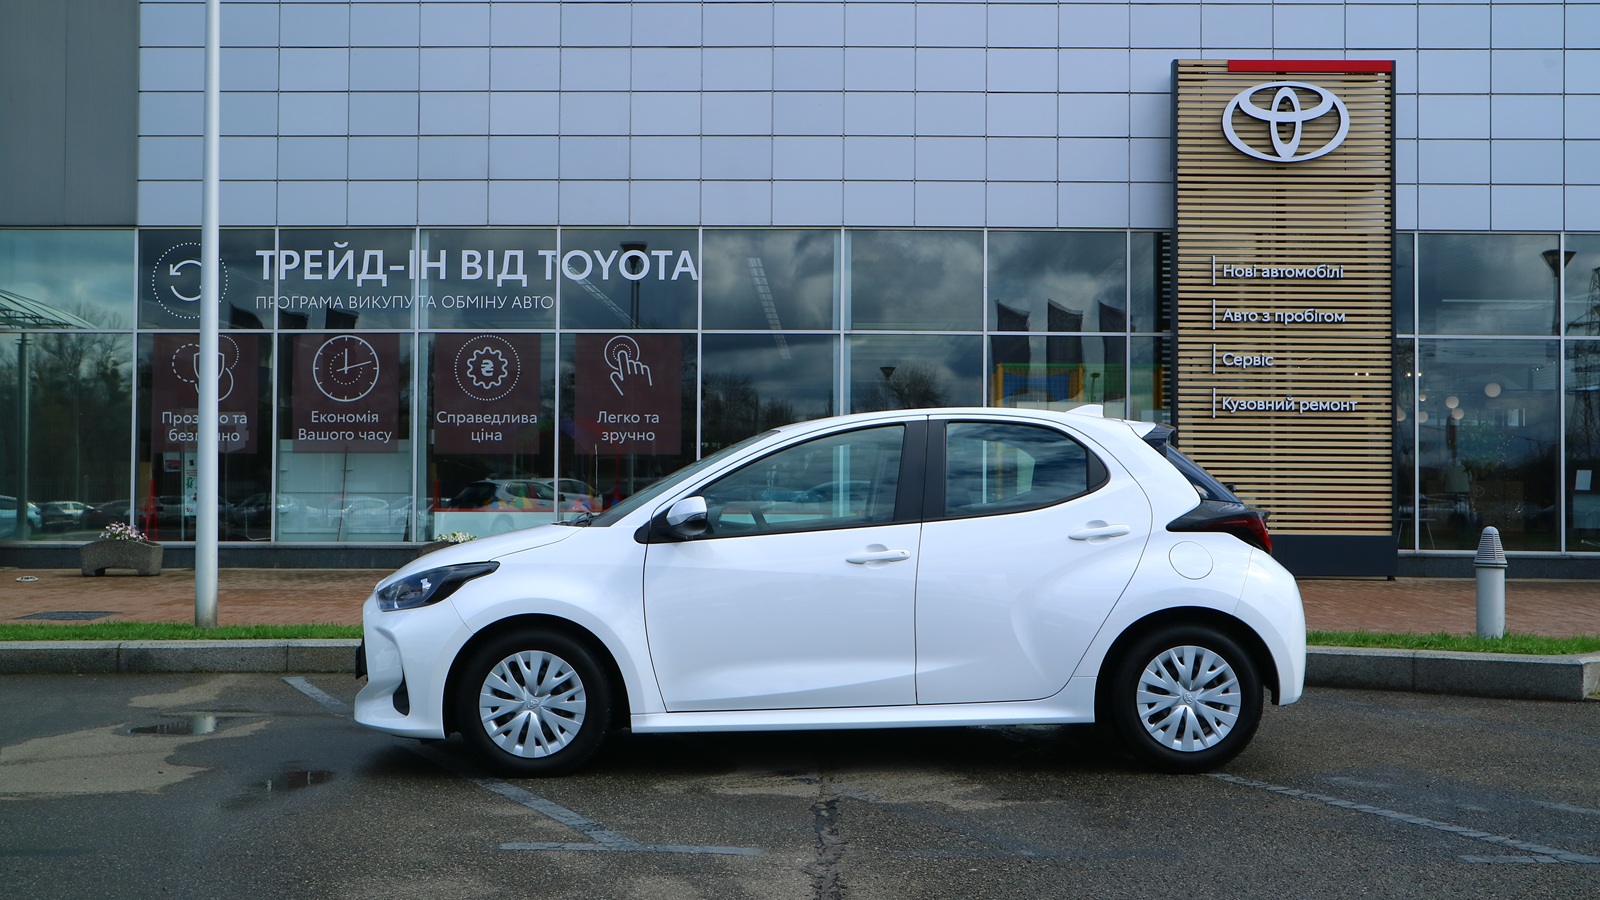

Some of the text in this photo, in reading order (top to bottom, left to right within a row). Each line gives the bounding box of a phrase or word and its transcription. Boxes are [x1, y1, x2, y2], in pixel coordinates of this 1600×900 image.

[461, 249, 528, 287] ВІД
[538, 249, 699, 281] TOYOTA
[1222, 264, 1345, 279] Нові автомобілі
[255, 295, 554, 310] ПРОГРАМА ВИКУПУ ТА ОБМІНУ АВТО
[1222, 308, 1346, 326] Авто з пробігом
[1222, 352, 1274, 369] Сервіс
[1221, 397, 1358, 414] Кузовний ремонт
[161, 411, 248, 427] Прозо та
[311, 410, 379, 424] Економія
[436, 410, 538, 426] Справедлива
[596, 411, 660, 424] Легко та
[168, 428, 241, 442] безно
[298, 428, 392, 444] Вашого часу
[471, 428, 503, 444] ціна
[601, 430, 656, 445] зручно
